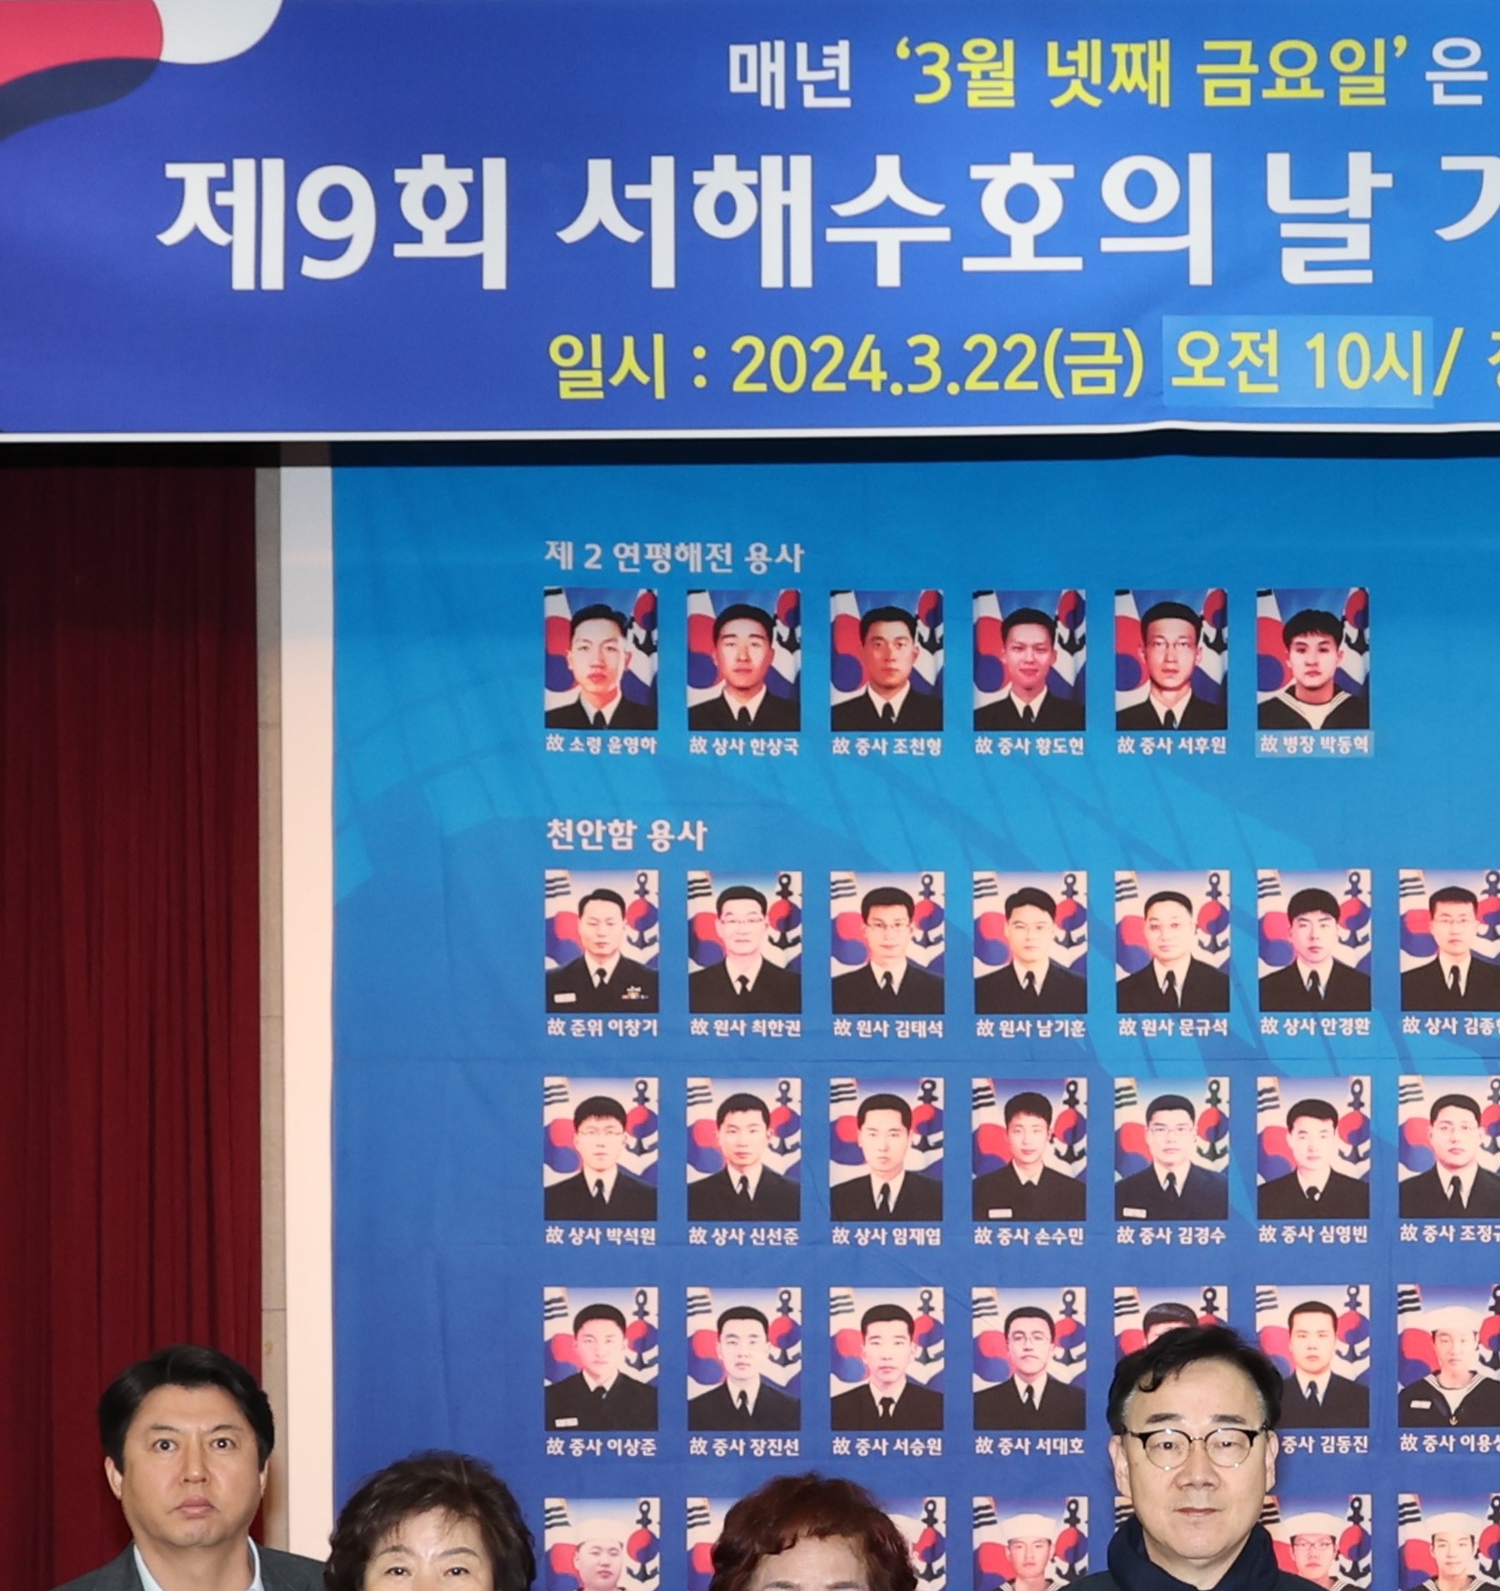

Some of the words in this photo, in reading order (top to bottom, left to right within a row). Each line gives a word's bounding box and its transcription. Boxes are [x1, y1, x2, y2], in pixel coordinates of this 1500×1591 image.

[729, 39, 852, 110] 매년
[1047, 39, 1170, 108] 넷째
[156, 154, 507, 291] 제9회
[557, 151, 1213, 289] 서해수호의
[1266, 151, 1393, 285] 날
[549, 333, 665, 400] 일시
[693, 345, 707, 388] :
[731, 327, 1144, 399] 2024.3.22(금)
[1171, 328, 1280, 394] 오전
[1305, 327, 1464, 396] 10시/
[544, 540, 574, 571] 제
[583, 543, 603, 570] 2
[613, 541, 733, 574] 연평해전
[745, 542, 805, 576] 용사
[546, 734, 564, 752] 故
[570, 736, 602, 755] 소령
[690, 736, 707, 754] 故
[712, 738, 745, 756] 상사
[832, 737, 850, 755] 故
[855, 738, 888, 756] 중사
[975, 736, 993, 754] 故
[998, 737, 1031, 756] 중사
[1117, 736, 1135, 754] 故
[1140, 737, 1173, 755] 중사
[1260, 734, 1279, 754] 故
[1282, 735, 1316, 755] 병장
[546, 818, 638, 852] 천안함
[646, 818, 709, 854] 용사
[547, 1017, 566, 1036] 故
[570, 1019, 603, 1038] 준위
[690, 1018, 709, 1036] 故
[713, 1019, 747, 1037] 원사
[833, 1018, 852, 1037] 故
[856, 1019, 890, 1038] 원사
[976, 1018, 995, 1037] 故
[999, 1019, 1033, 1038] 원사
[1260, 1016, 1279, 1035] 故
[1283, 1017, 1317, 1037] 상사
[1402, 1015, 1421, 1034] 故
[1424, 1017, 1459, 1036] 상사
[545, 1225, 565, 1244] 故
[568, 1227, 603, 1246] 상사
[688, 1226, 708, 1245] 故
[711, 1227, 746, 1247] 상사
[831, 1226, 851, 1245] 故
[854, 1227, 888, 1247] 상사
[974, 1226, 993, 1245] 故
[996, 1227, 1031, 1247] 중사
[1116, 1225, 1135, 1244] 故
[1138, 1226, 1173, 1246] 중사
[1399, 1223, 1419, 1242] 故
[1422, 1224, 1456, 1244] 중사
[546, 1437, 565, 1456] 故
[569, 1438, 603, 1457] 중사
[689, 1436, 708, 1456] 故
[712, 1438, 746, 1457] 중사
[832, 1436, 851, 1455] 故
[855, 1438, 889, 1457] 중사
[975, 1436, 994, 1455] 故
[997, 1437, 1032, 1456] 중사
[1399, 1433, 1419, 1452] 故
[1422, 1434, 1456, 1453] 중사
